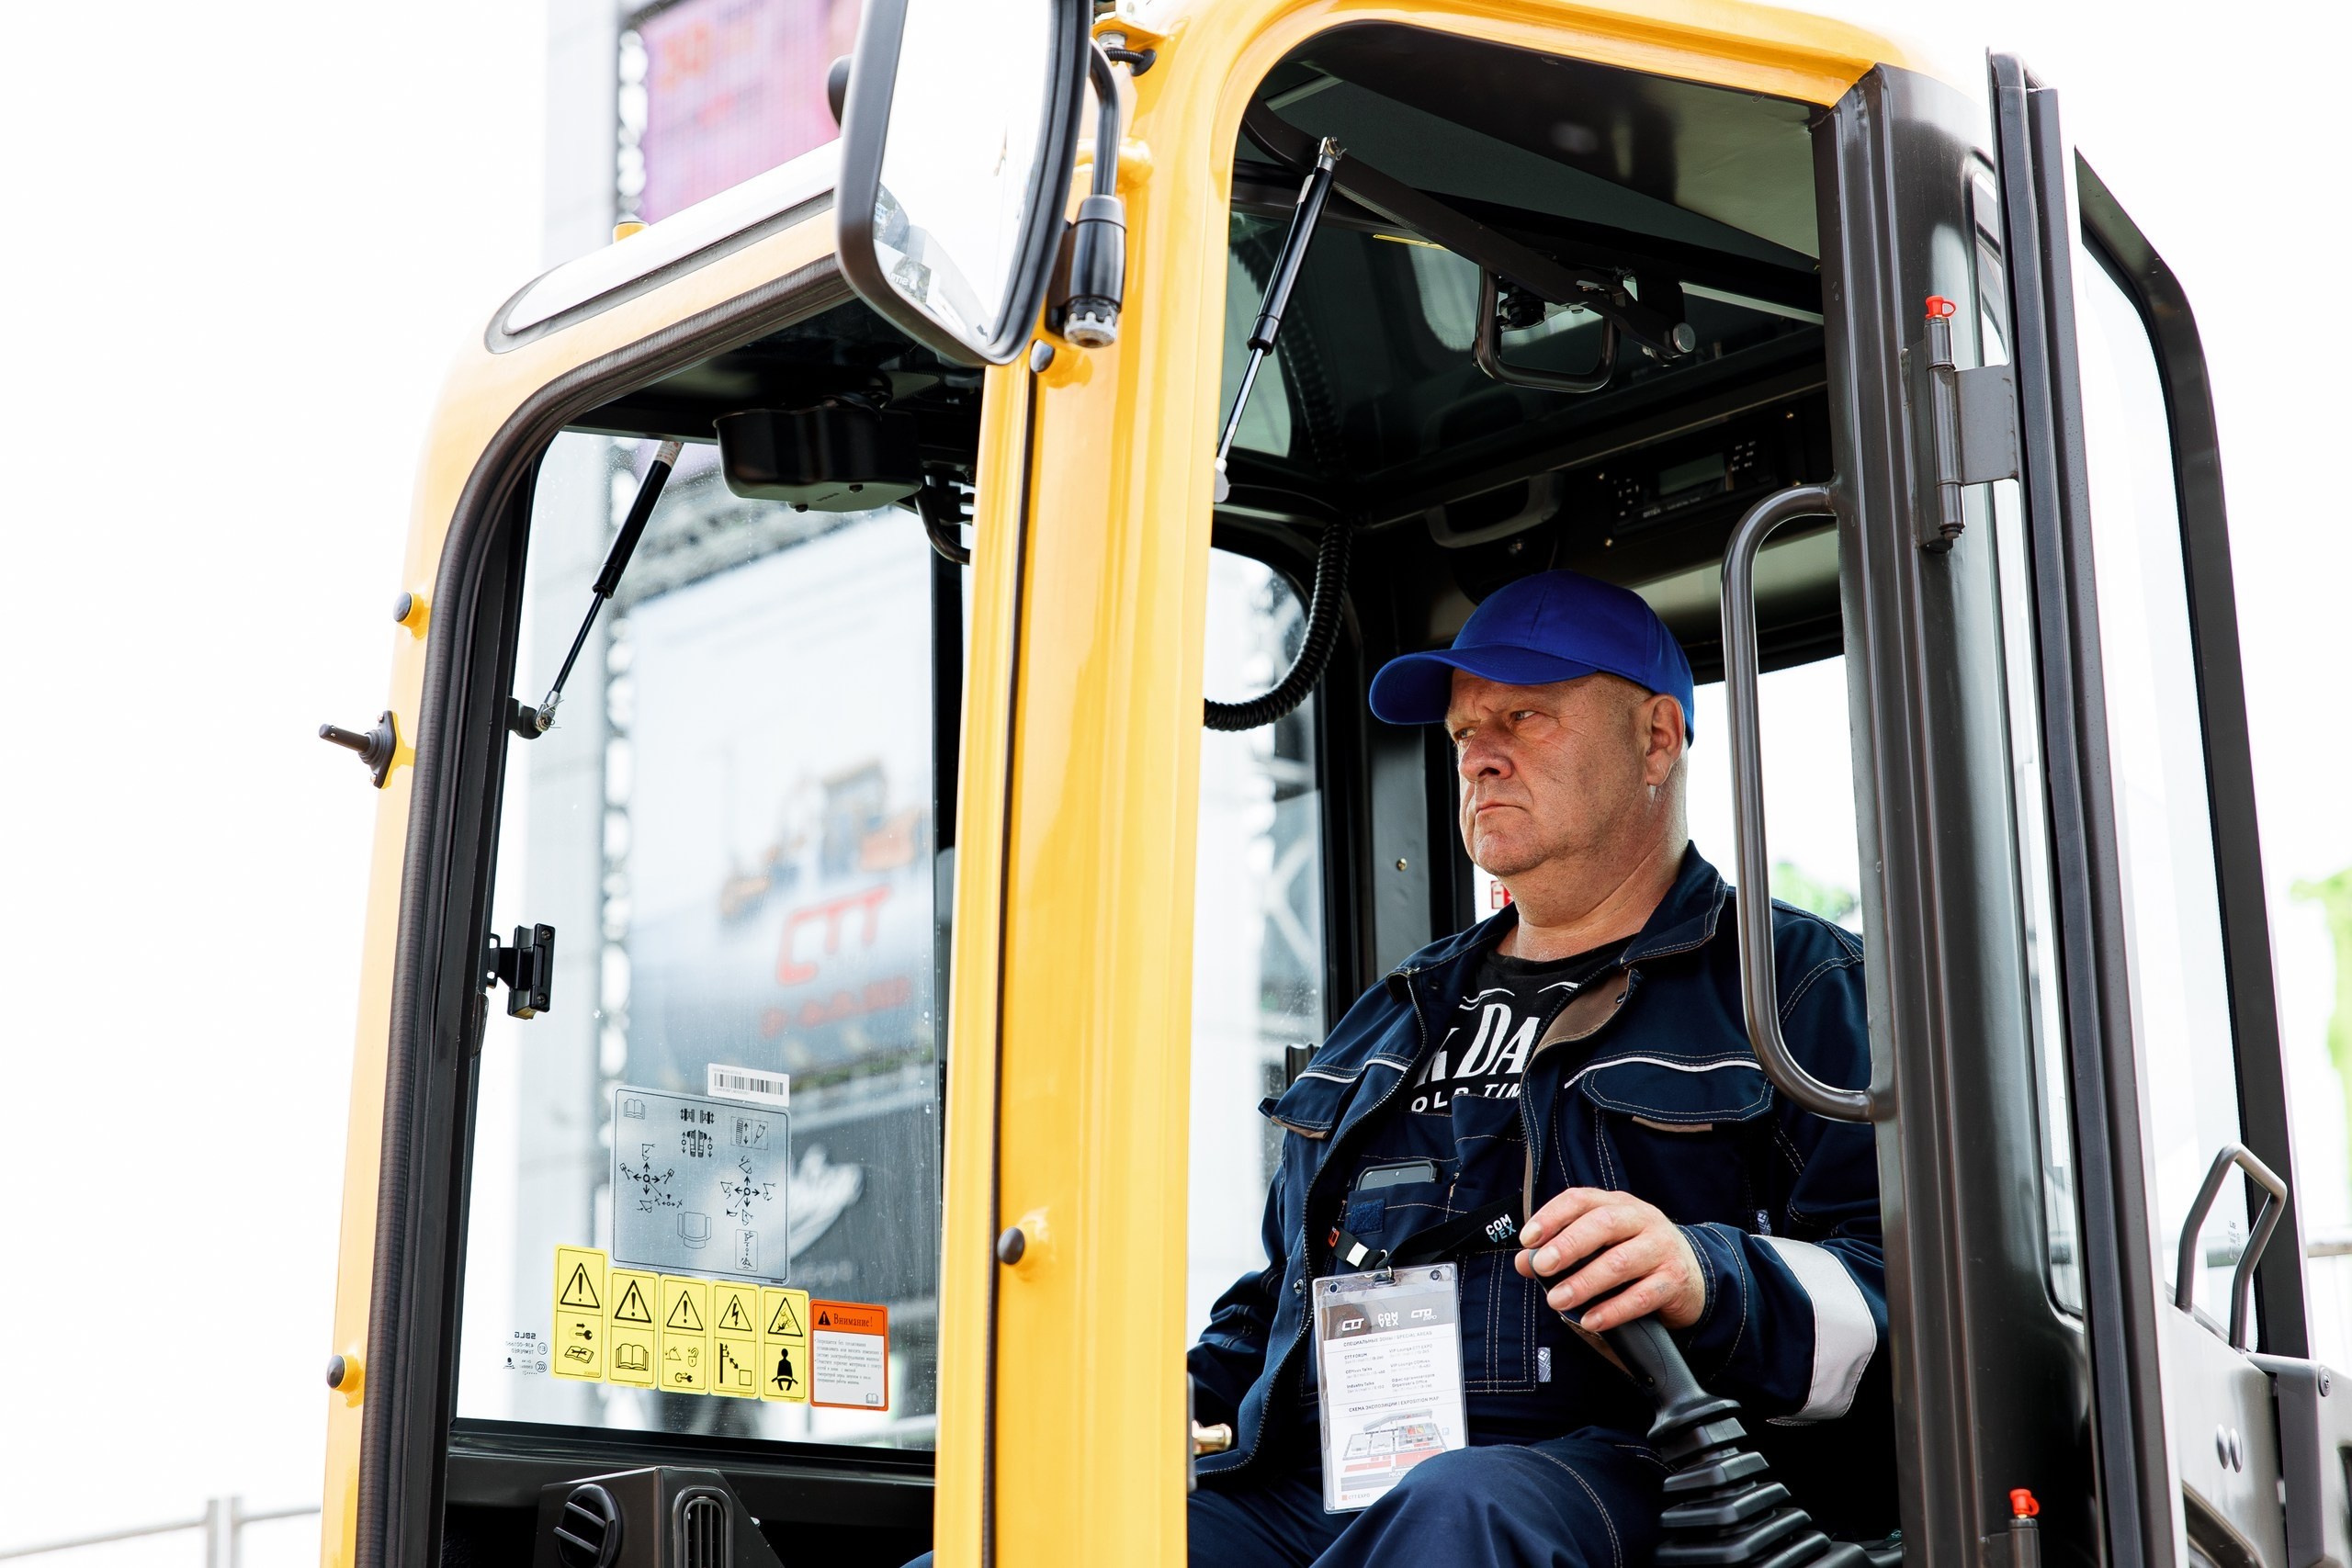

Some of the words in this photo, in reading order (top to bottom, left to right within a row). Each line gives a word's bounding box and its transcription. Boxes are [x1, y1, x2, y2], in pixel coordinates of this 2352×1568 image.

[777, 885, 891, 986] CTT
[1485, 1213, 1512, 1235] COM
[1489, 1223, 1517, 1243] VEX
[833, 1313, 873, 1327] Внимание!
[1378, 1312, 1399, 1321] COM
[1378, 1318, 1399, 1328] VEX
[1341, 1318, 1364, 1331] CTT
[1400, 1397, 1428, 1405] EXPOSITION
